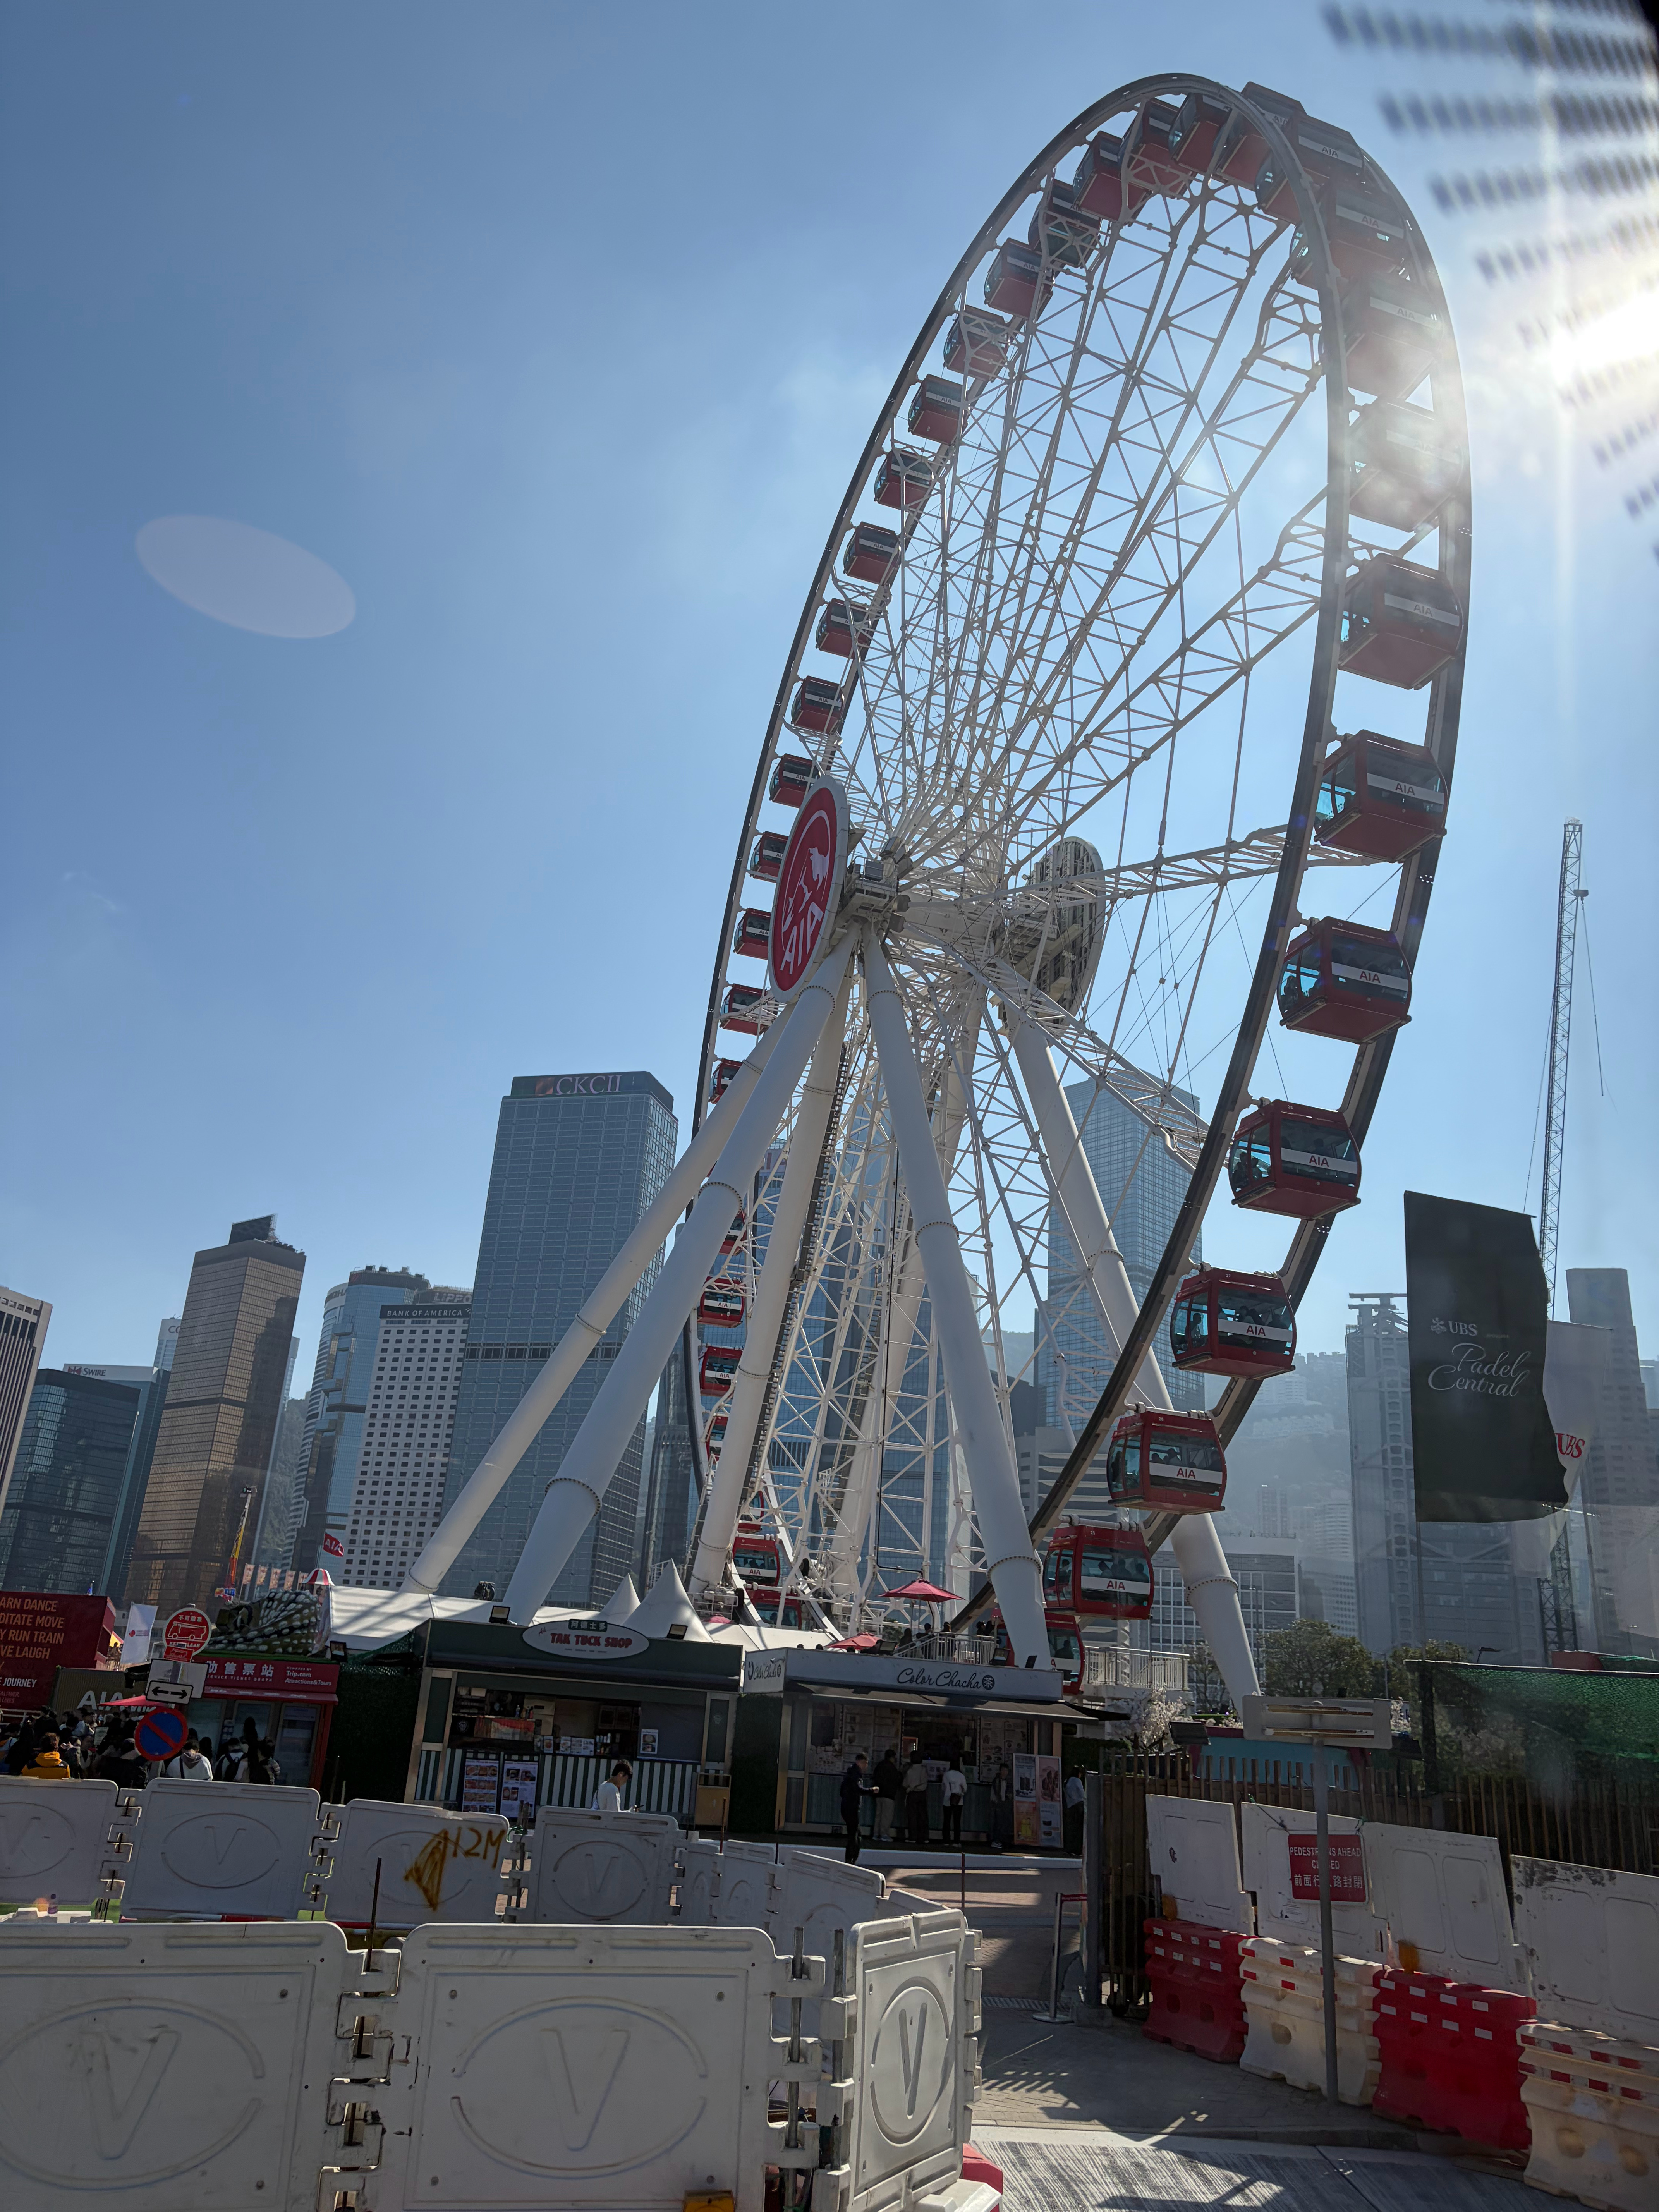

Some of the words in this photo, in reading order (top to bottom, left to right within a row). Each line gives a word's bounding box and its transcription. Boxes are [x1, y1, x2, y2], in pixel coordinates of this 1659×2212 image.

[1322, 146, 1339, 158] AIA
[1362, 216, 1379, 228] AIA
[1413, 604, 1433, 617] AIA
[1395, 783, 1416, 796] AIA
[780, 902, 824, 974] AIA
[1359, 971, 1381, 984] AIA
[1309, 1154, 1329, 1167] AIA
[433, 1292, 472, 1304] LIPPO
[1247, 1324, 1266, 1337] AIA
[1448, 1321, 1478, 1336] UBS
[1452, 1343, 1532, 1377] Padel
[1428, 1365, 1531, 1397] Central
[1555, 1433, 1585, 1458] UBS
[1176, 1467, 1196, 1479] AIA
[1106, 1580, 1125, 1590] AIA
[24, 1598, 58, 1612] DANCE
[36, 1616, 65, 1628] MOVE
[8, 1629, 30, 1642] RUN
[34, 1631, 64, 1644] TRAIN
[550, 1633, 570, 1644] TAK
[574, 1635, 601, 1646] TUCK
[605, 1637, 632, 1648] SHOP
[15, 1646, 51, 1659] LAUGH
[2, 1678, 37, 1688] JOURNEY
[897, 1668, 934, 1685] Color
[936, 1671, 981, 1689] Chacha
[1290, 1847, 1336, 1856] PEDESTRNS
[1337, 1848, 1361, 1857] AHEAD
[1312, 1860, 1340, 1870] CLED
[1294, 1874, 1363, 1889] 前面行路封閉
